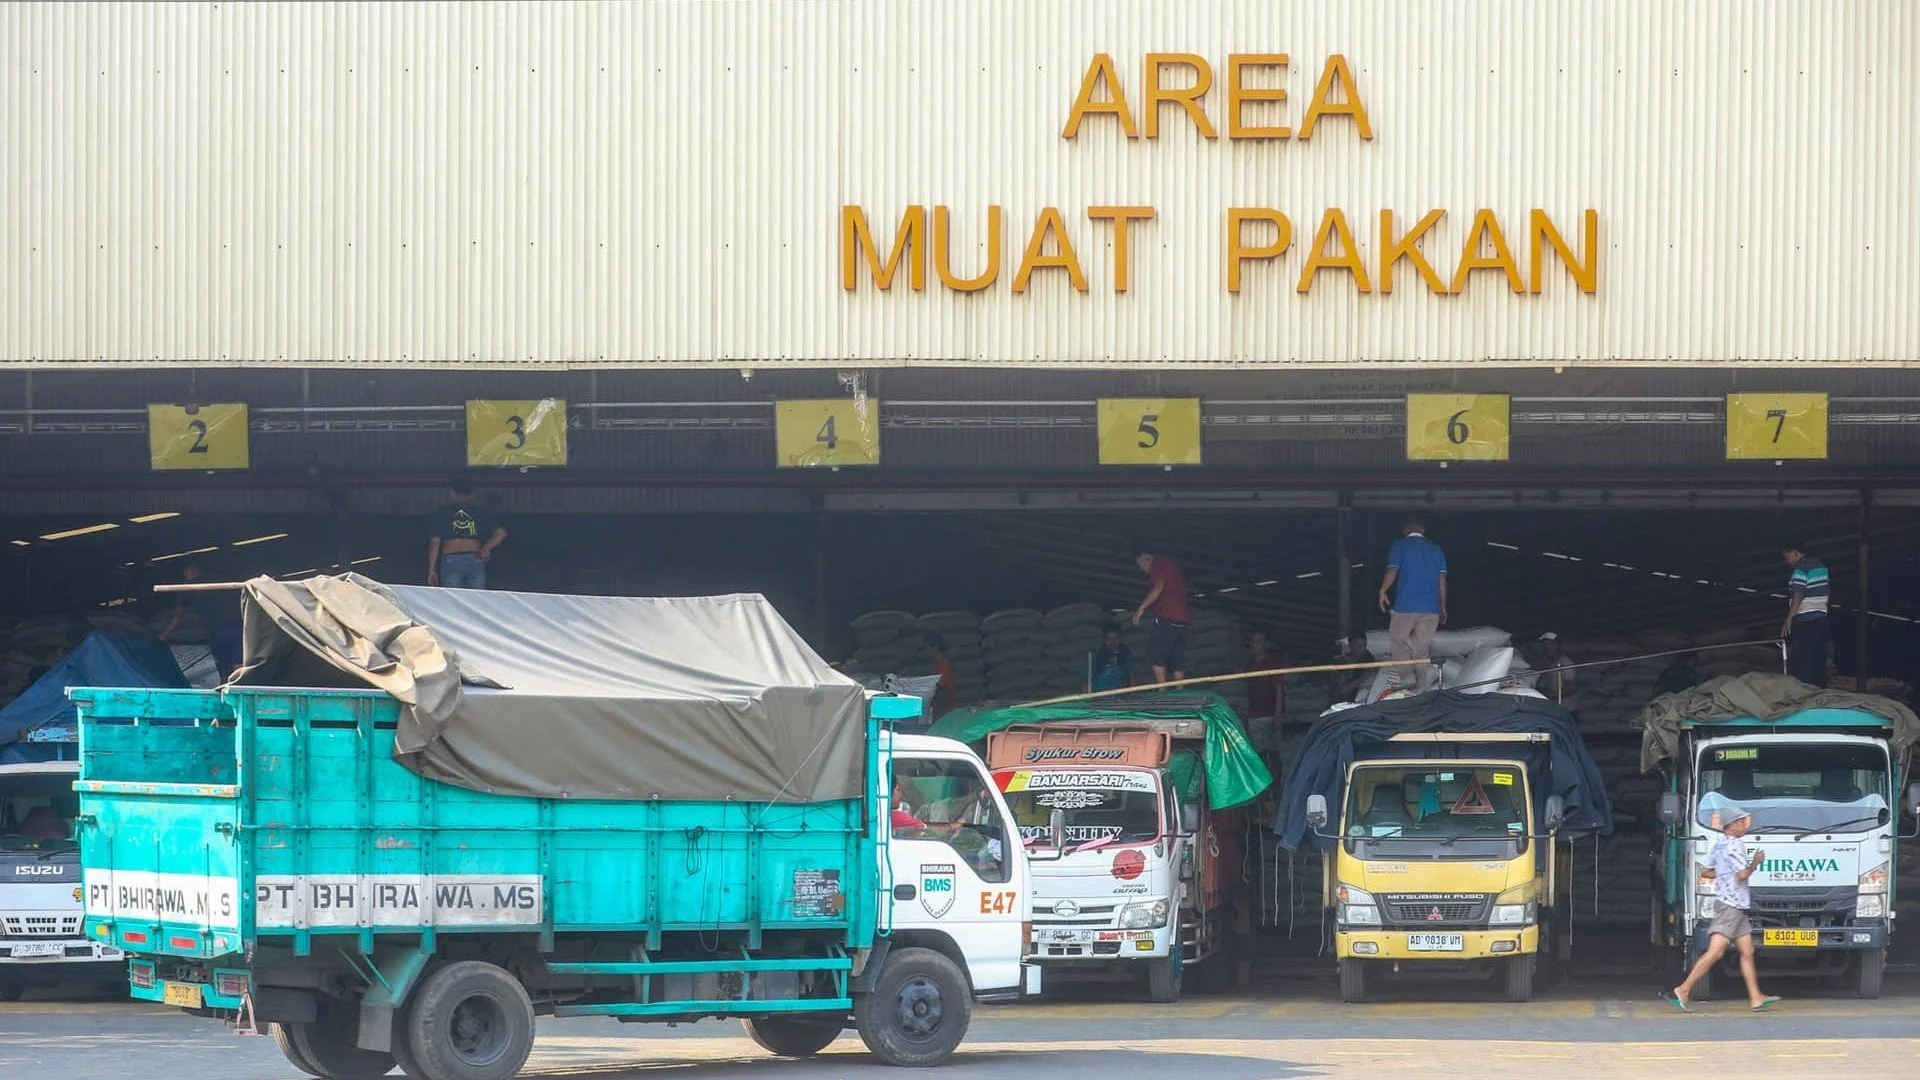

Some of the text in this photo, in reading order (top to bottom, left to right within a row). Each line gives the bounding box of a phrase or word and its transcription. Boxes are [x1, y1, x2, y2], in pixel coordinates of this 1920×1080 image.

[1062, 53, 1373, 140] AREA
[842, 205, 1597, 295] MUAT PAKAN
[188, 419, 209, 454] 2
[505, 415, 525, 450] 3
[816, 414, 837, 449] 4
[1138, 414, 1160, 449] 5
[1447, 410, 1469, 445] 6
[1765, 409, 1787, 444] 7
[1024, 747, 1081, 762] Syukur
[1029, 773, 1127, 788] BANJARSARI
[16, 866, 63, 875] ISUZU
[1748, 858, 1839, 872] HIRAWA
[1769, 873, 1816, 882] ISUZU
[924, 878, 951, 892] BMS
[980, 892, 1016, 914] E47
[1410, 935, 1421, 945] AD
